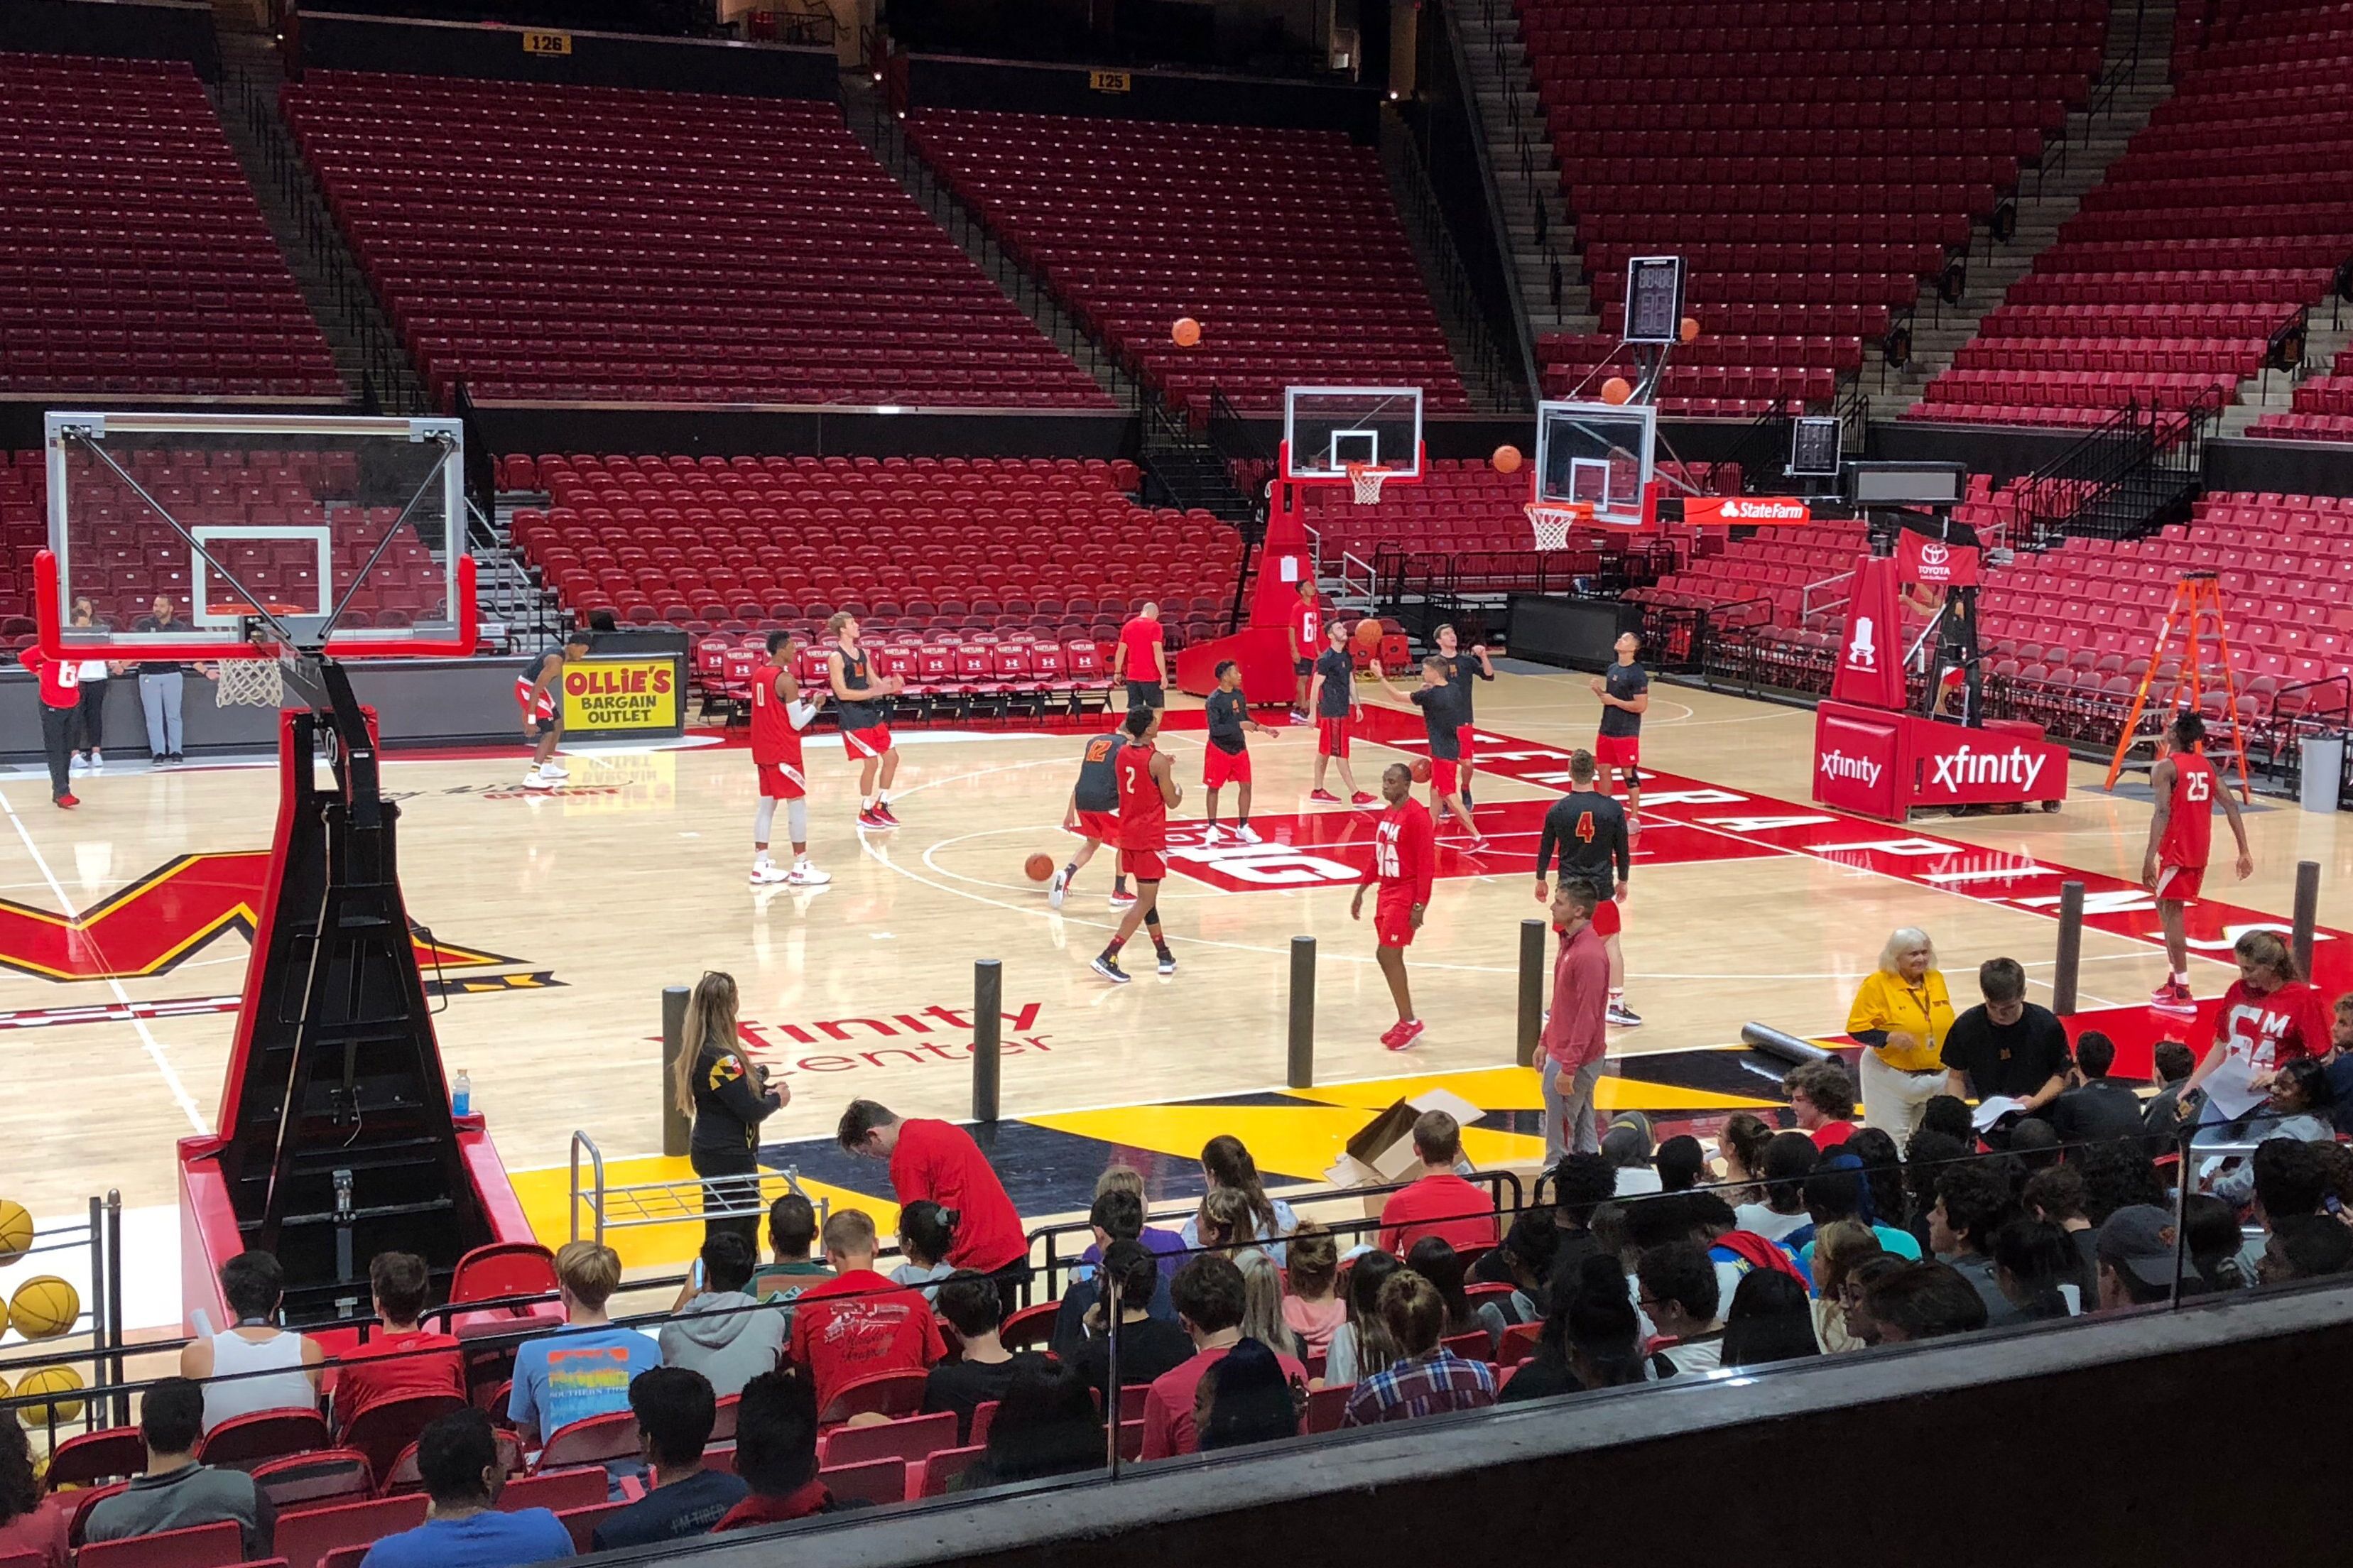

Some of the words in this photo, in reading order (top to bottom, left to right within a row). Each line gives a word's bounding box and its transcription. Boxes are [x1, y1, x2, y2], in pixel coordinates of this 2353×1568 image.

[533, 36, 562, 51] 126
[1098, 74, 1123, 87] 125
[1918, 565, 1950, 575] TOYOTA
[581, 695, 657, 709] BARGAIN
[756, 682, 765, 707] 0
[588, 709, 651, 723] OUTLET
[1125, 766, 1135, 794] 2
[1820, 749, 1881, 788] xfinity
[1932, 745, 2046, 793] xfinity
[2187, 771, 2209, 801] 25
[1575, 811, 1595, 844] 4
[641, 1002, 1042, 1056] finity
